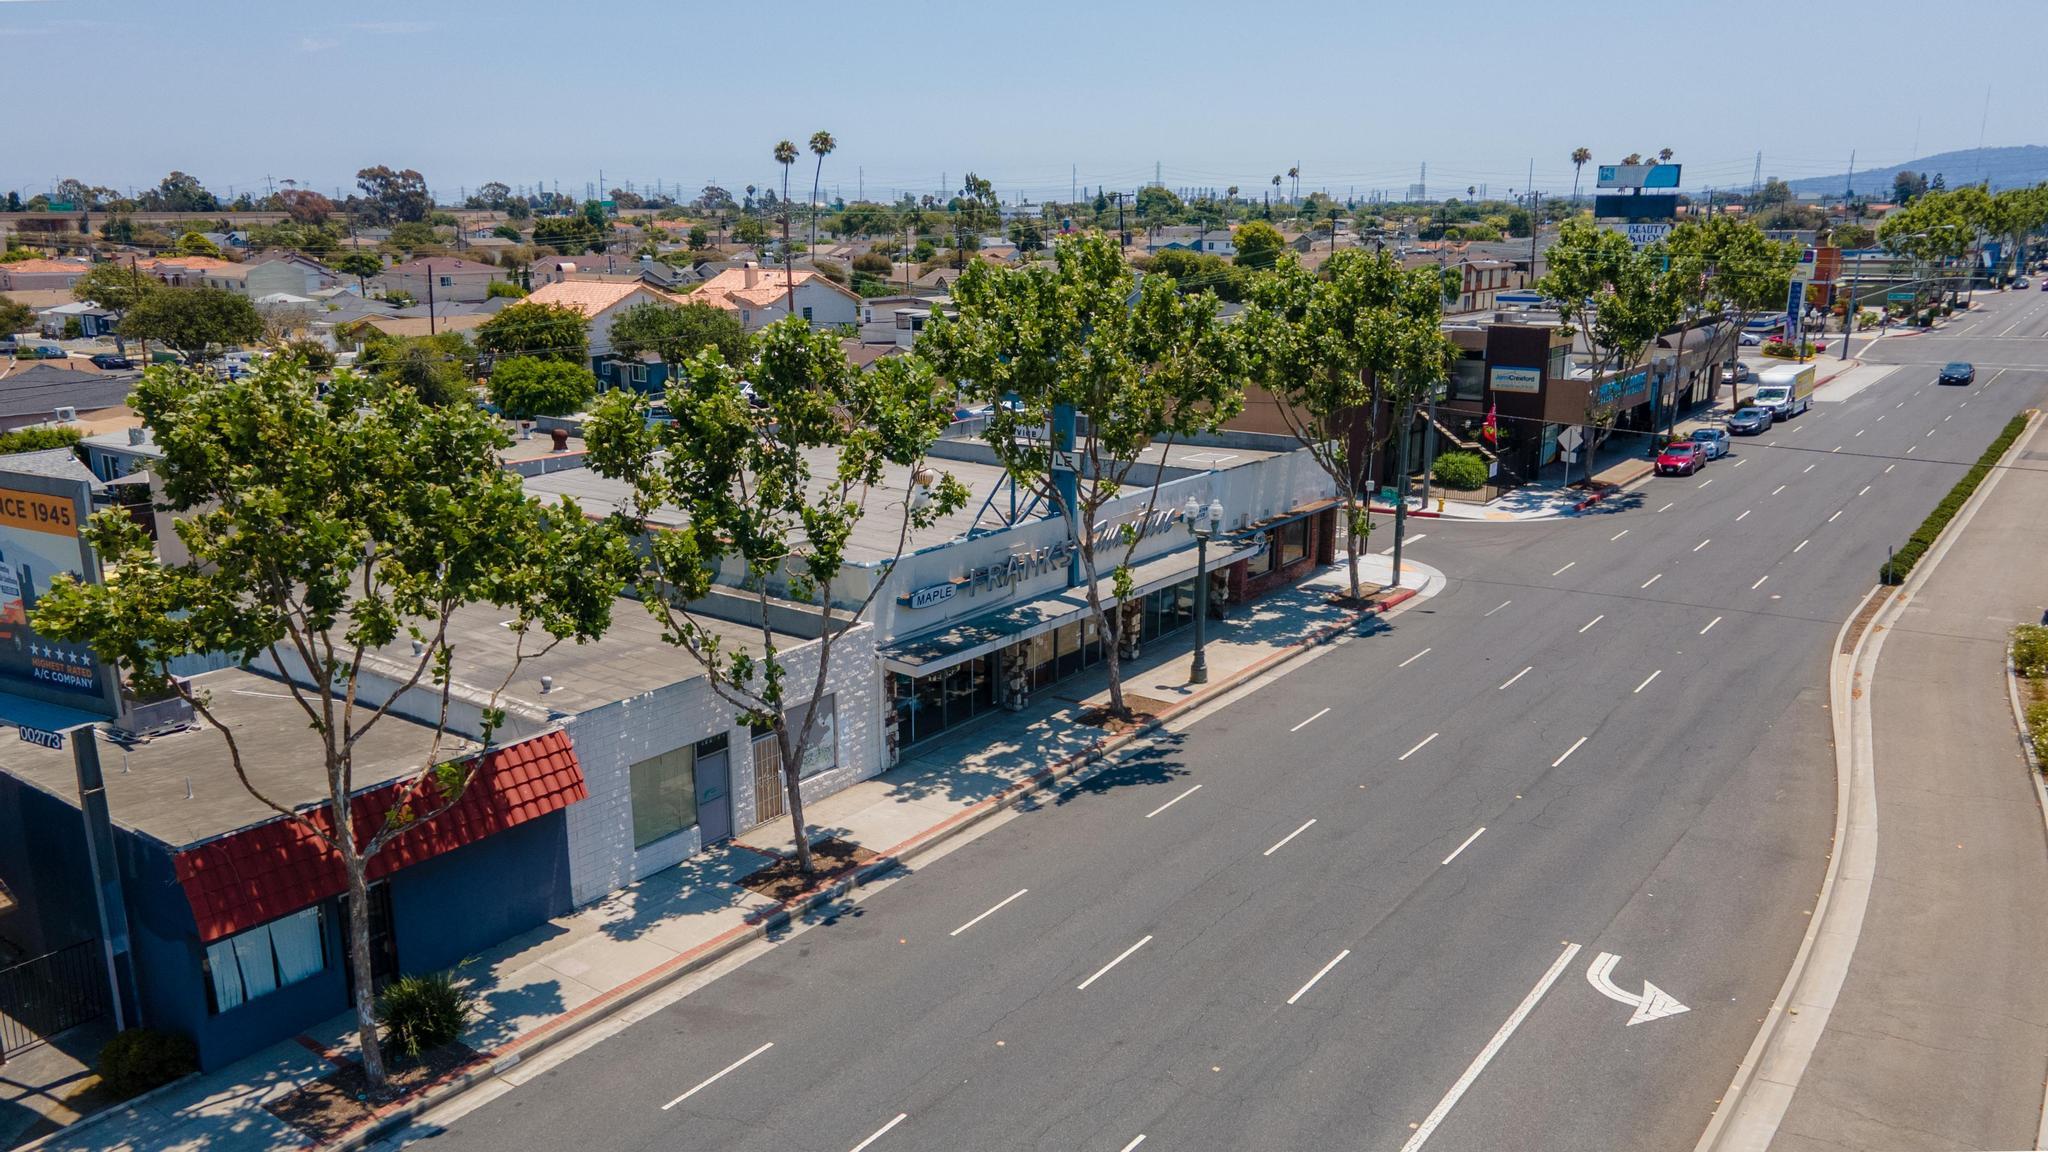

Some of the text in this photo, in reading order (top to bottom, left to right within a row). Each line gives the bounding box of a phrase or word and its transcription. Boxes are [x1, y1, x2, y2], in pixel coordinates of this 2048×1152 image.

[1628, 225, 1666, 234] BEAUTY
[31, 502, 70, 526] 1945
[916, 586, 952, 606] MAPLE
[32, 656, 93, 678] HIGHEST RATED
[34, 667, 93, 689] A/C COMPANY
[20, 726, 61, 748] 002773
